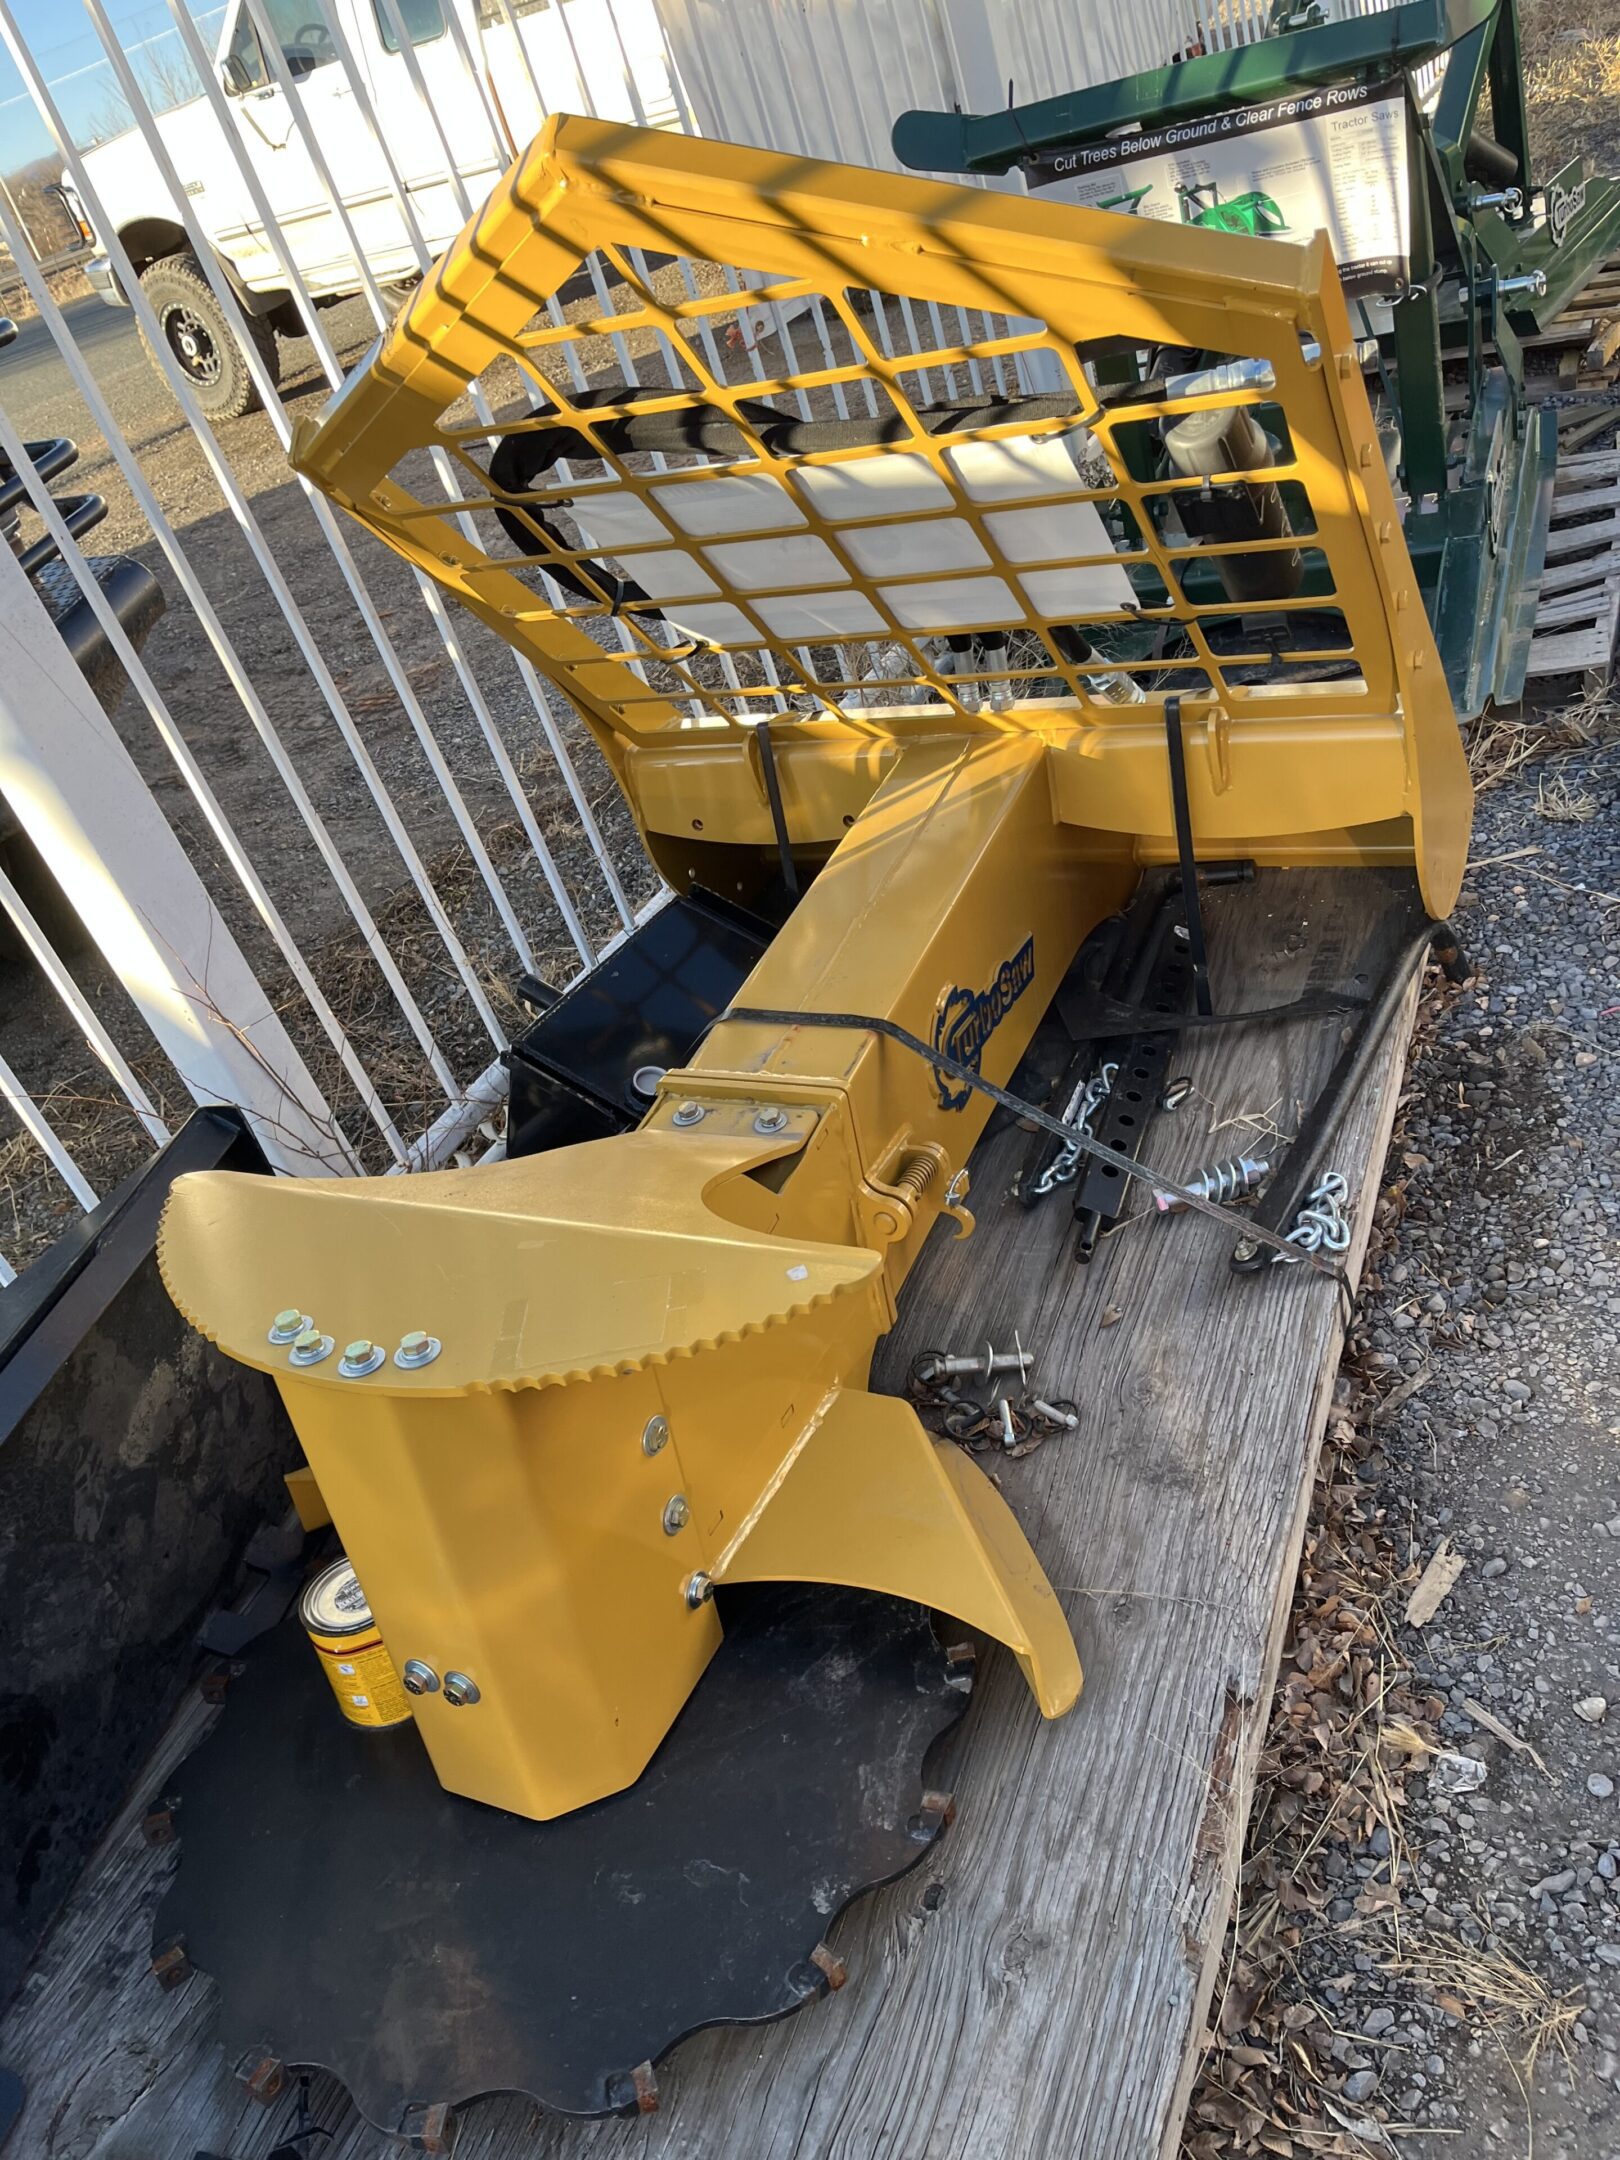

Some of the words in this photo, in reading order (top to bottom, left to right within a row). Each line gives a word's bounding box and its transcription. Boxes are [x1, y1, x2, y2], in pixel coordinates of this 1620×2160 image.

[1054, 156, 1077, 172] Cut
[1081, 147, 1117, 166] Trees
[1120, 135, 1162, 156] Below
[1165, 120, 1217, 144] Ground
[1221, 116, 1232, 131] &
[1235, 107, 1275, 127] Clear
[1277, 96, 1322, 118] Fence
[1326, 85, 1368, 107] Rows
[1331, 115, 1368, 132] Tractor
[1371, 110, 1399, 123] Saws
